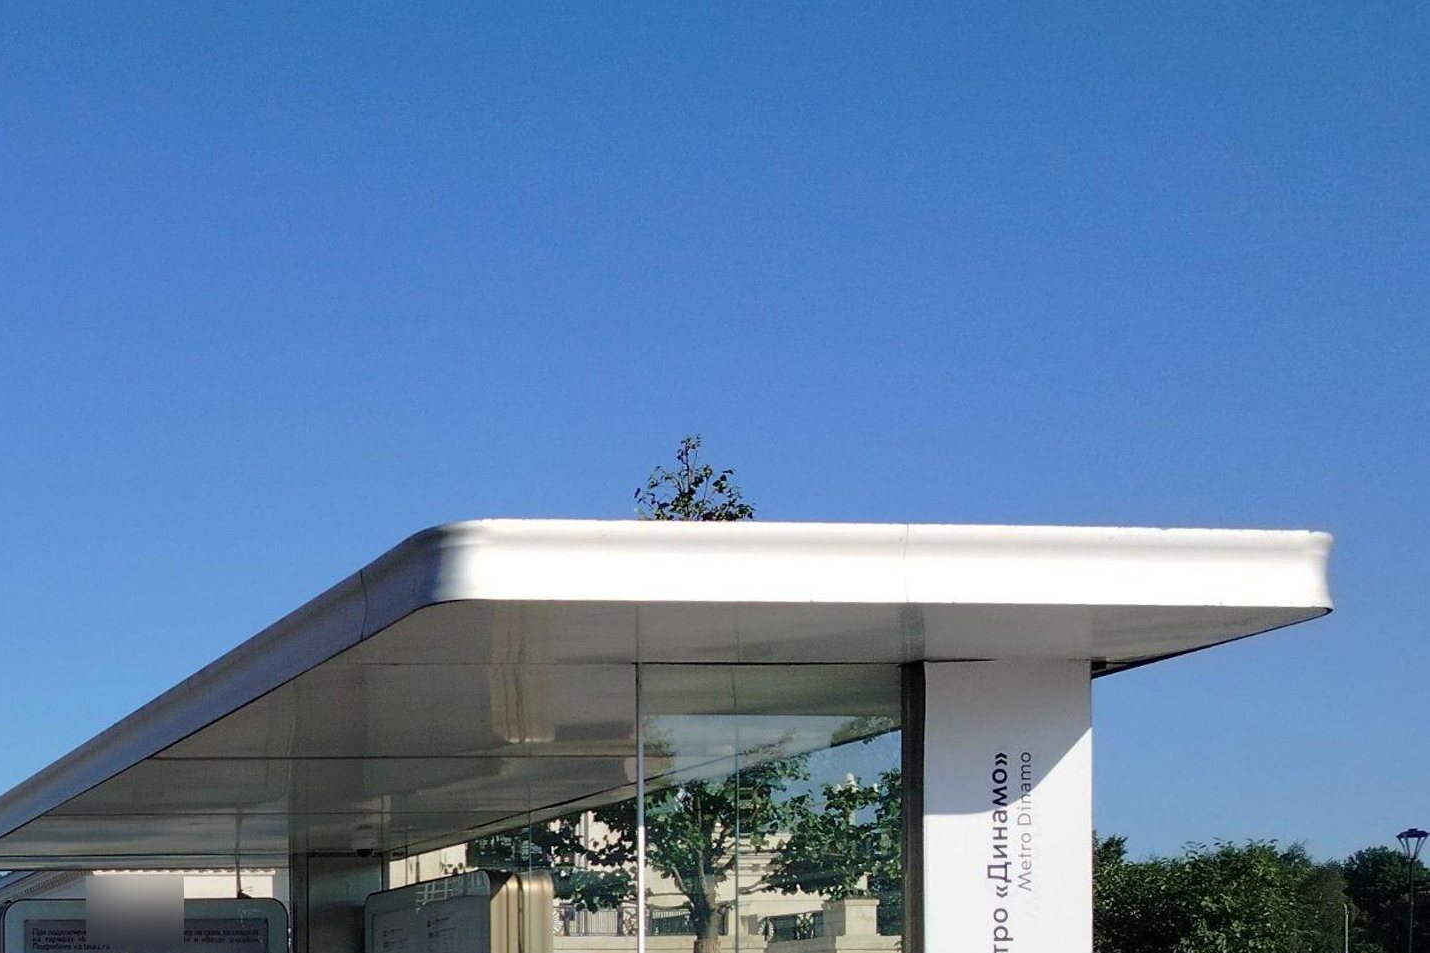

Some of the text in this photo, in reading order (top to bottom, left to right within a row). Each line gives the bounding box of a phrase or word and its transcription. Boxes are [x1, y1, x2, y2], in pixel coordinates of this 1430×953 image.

[987, 752, 1012, 898] «Динамо»
[1017, 752, 1032, 892] Metro Dinamo
